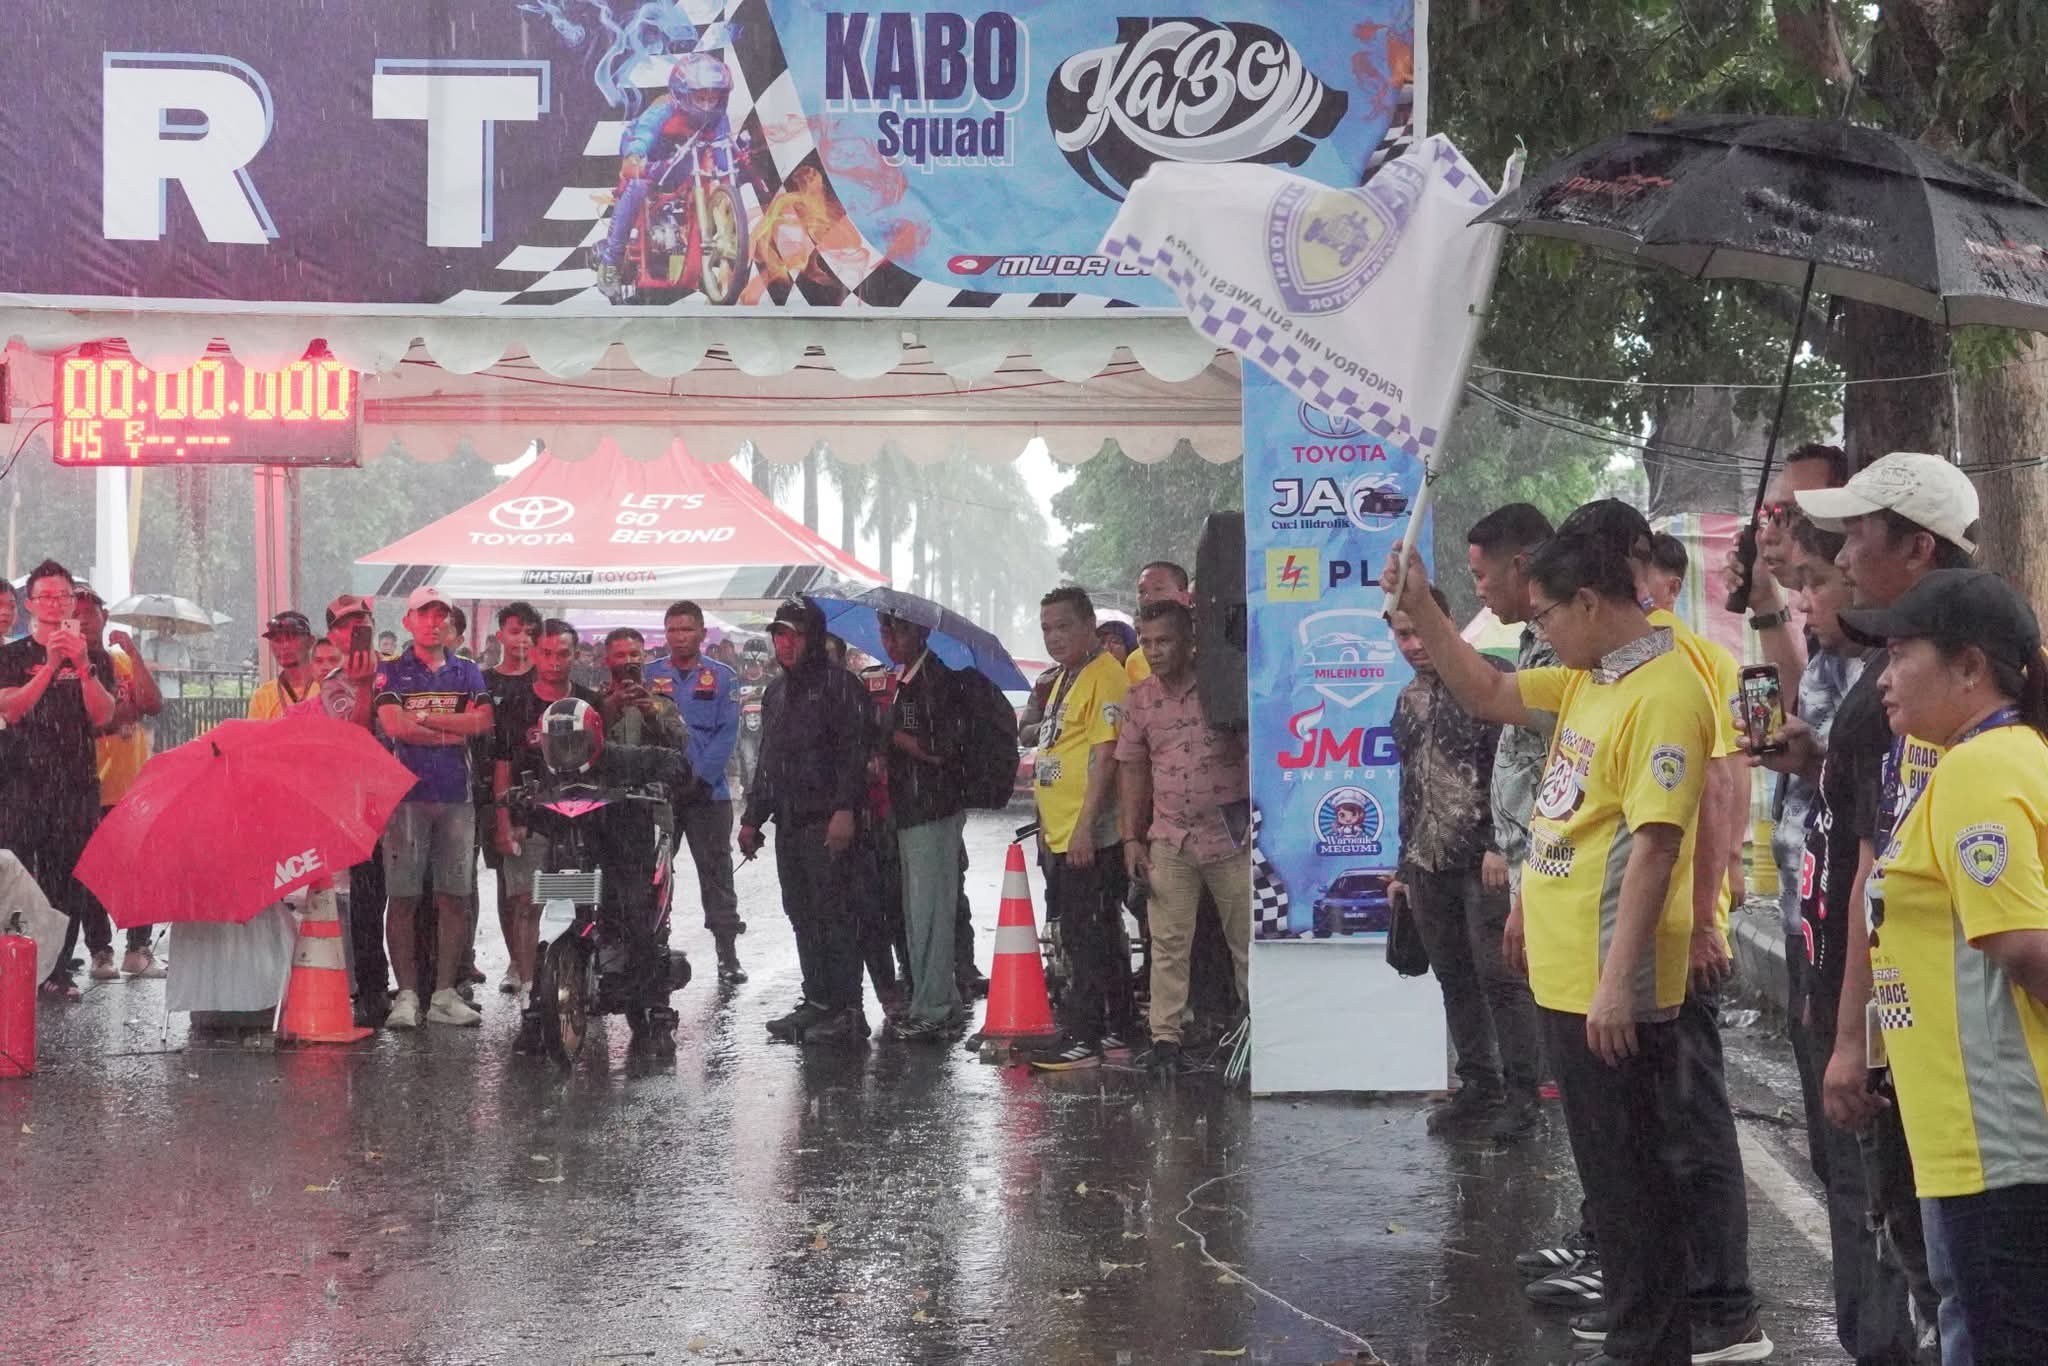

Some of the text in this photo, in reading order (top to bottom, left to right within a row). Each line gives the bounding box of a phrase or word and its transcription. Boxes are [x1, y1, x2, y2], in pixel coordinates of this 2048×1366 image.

[826, 12, 1018, 102] KABO
[878, 111, 1005, 164] Squad
[998, 256, 1109, 276] MUDA
[1292, 445, 1387, 463] TOYOTA
[620, 494, 704, 510] LET'S
[615, 512, 659, 526] GO
[1272, 519, 1349, 529] Cuci Hidrolik
[468, 532, 575, 545] TOYOTA
[609, 527, 735, 544] BEYOND
[597, 571, 657, 583] TOYOTA
[1329, 560, 1380, 588] PL
[1314, 668, 1384, 679] MILEIN OTO
[1277, 712, 1400, 769] JMG
[1908, 744, 1937, 768] DRAG
[1283, 769, 1397, 781] ENERGY
[1910, 769, 1933, 788] BIK
[1321, 845, 1377, 853] MEGUMI
[1546, 844, 1576, 861] RACE
[274, 848, 324, 890] ACE
[1879, 983, 1909, 1006] RACE
